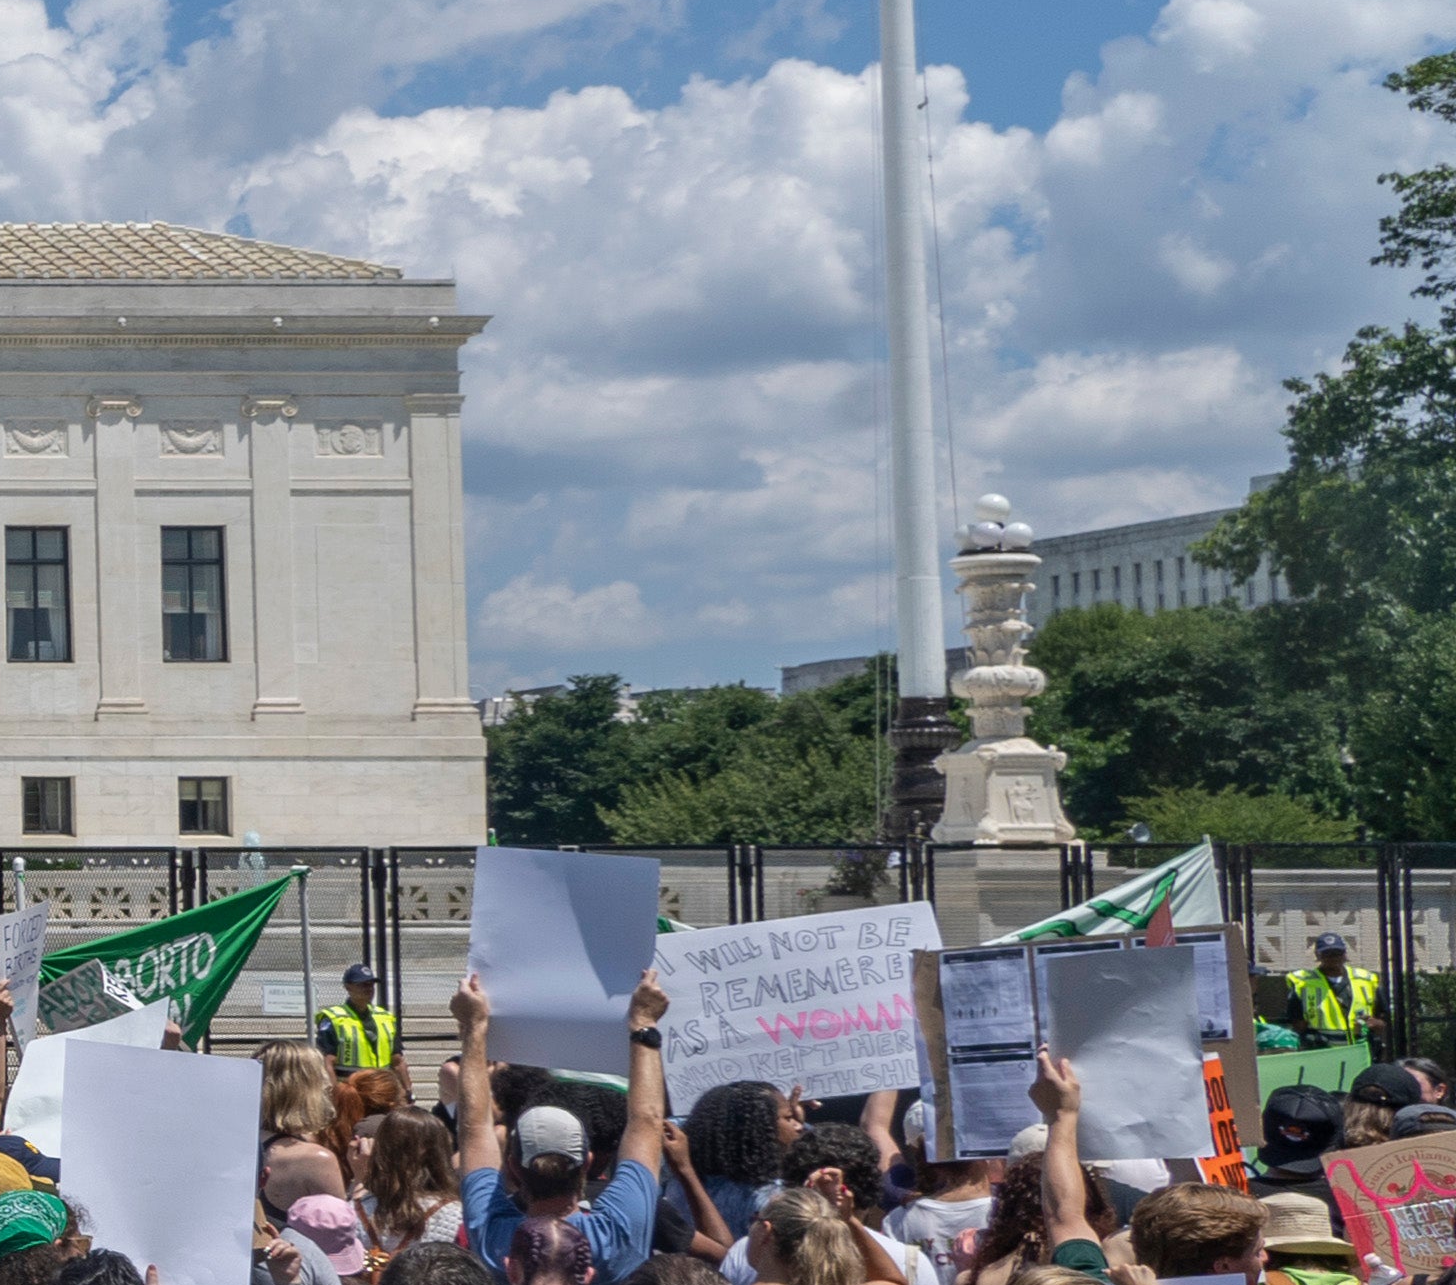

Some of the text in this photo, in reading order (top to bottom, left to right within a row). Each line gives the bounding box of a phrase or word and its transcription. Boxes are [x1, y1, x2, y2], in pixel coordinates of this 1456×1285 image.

[113, 932, 217, 999] BORTO
[685, 936, 762, 974] WILL
[769, 925, 845, 960] NOT
[857, 917, 911, 950] BE
[699, 953, 904, 1018] REMEMERE
[667, 1019, 709, 1063] AS
[718, 1015, 751, 1050] A
[748, 1041, 839, 1081] KEPT
[849, 1030, 915, 1060] HER
[862, 1058, 920, 1089] SHU
